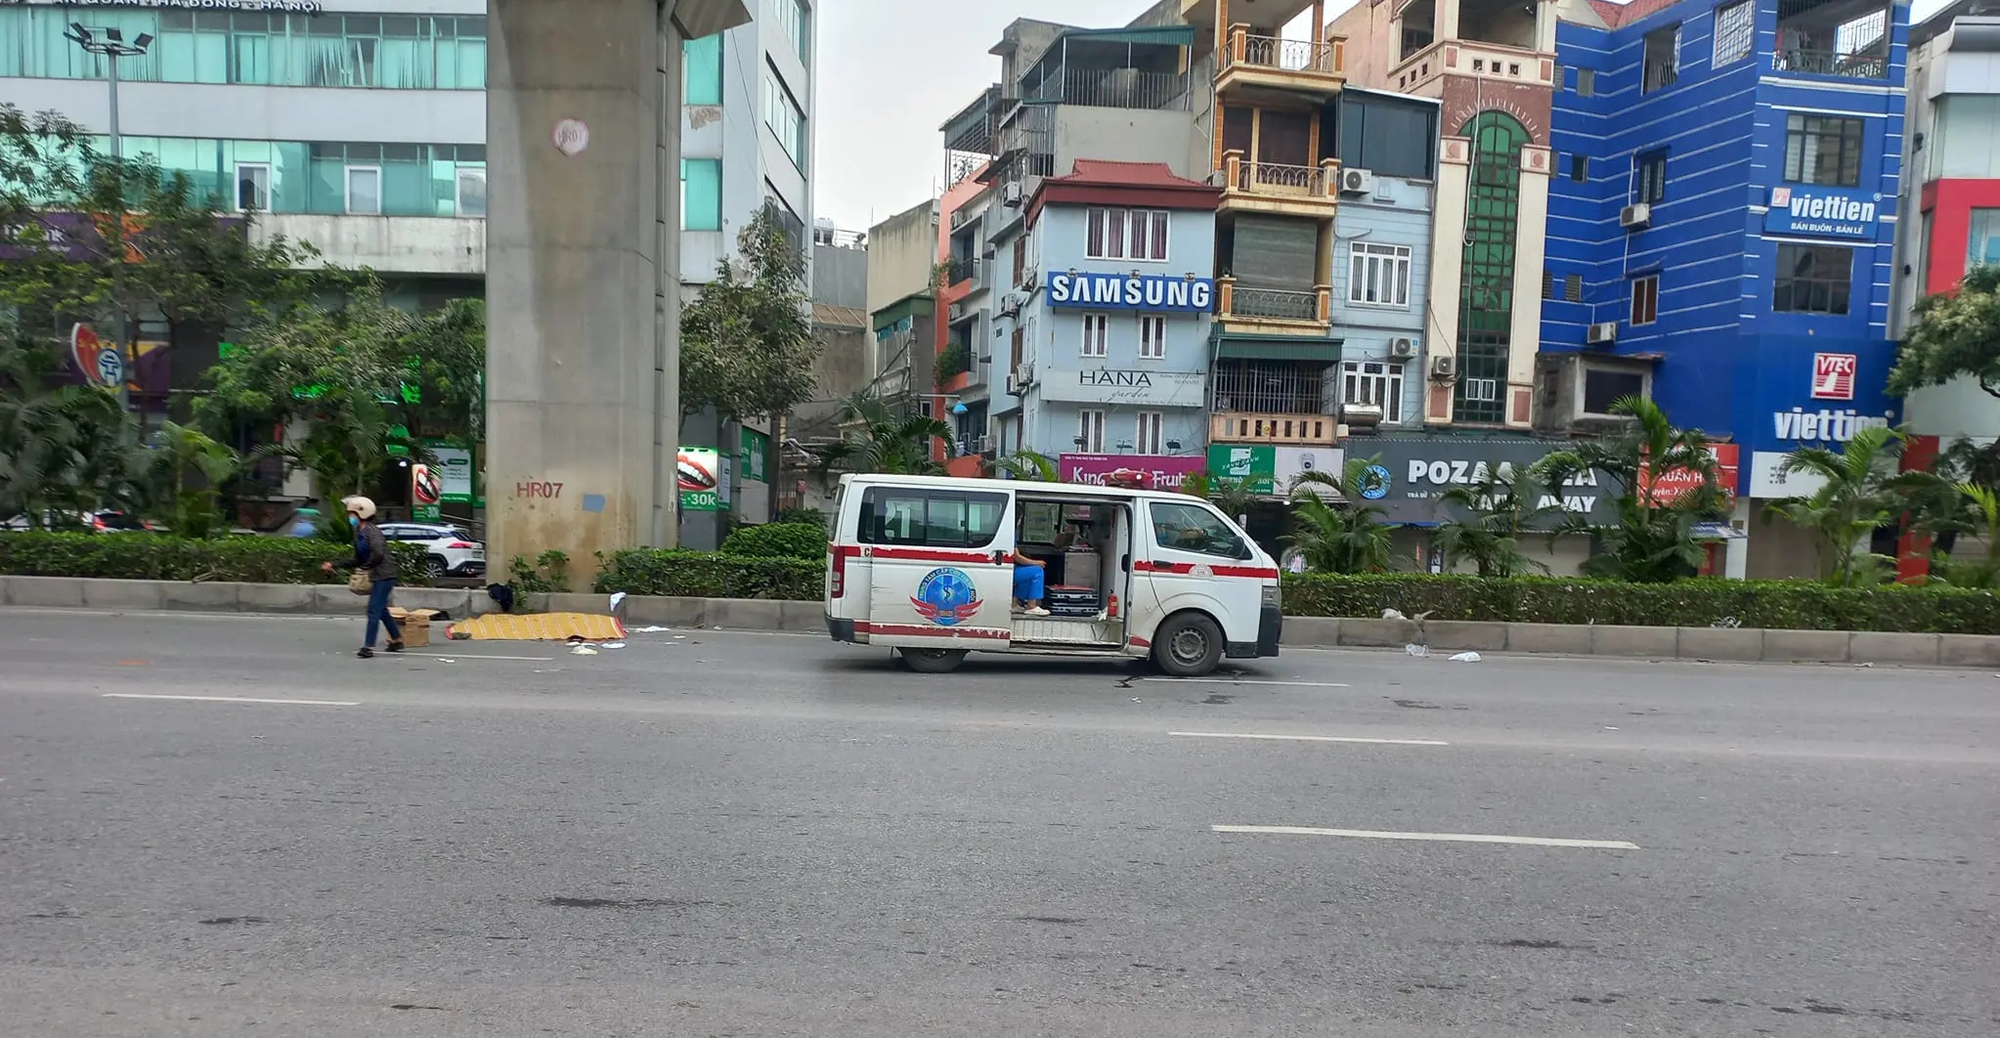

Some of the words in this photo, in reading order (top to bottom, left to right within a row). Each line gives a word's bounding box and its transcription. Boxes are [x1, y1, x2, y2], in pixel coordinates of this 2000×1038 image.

[1791, 194, 1875, 222] viettien
[1790, 221, 1808, 230] BÁN
[1809, 223, 1832, 232] BUÔN
[1836, 225, 1853, 234] BÁN
[1051, 275, 1210, 308] SAMSUNG
[1818, 356, 1855, 374] VTEC
[1079, 370, 1152, 387] HANA
[516, 481, 564, 499] HR07
